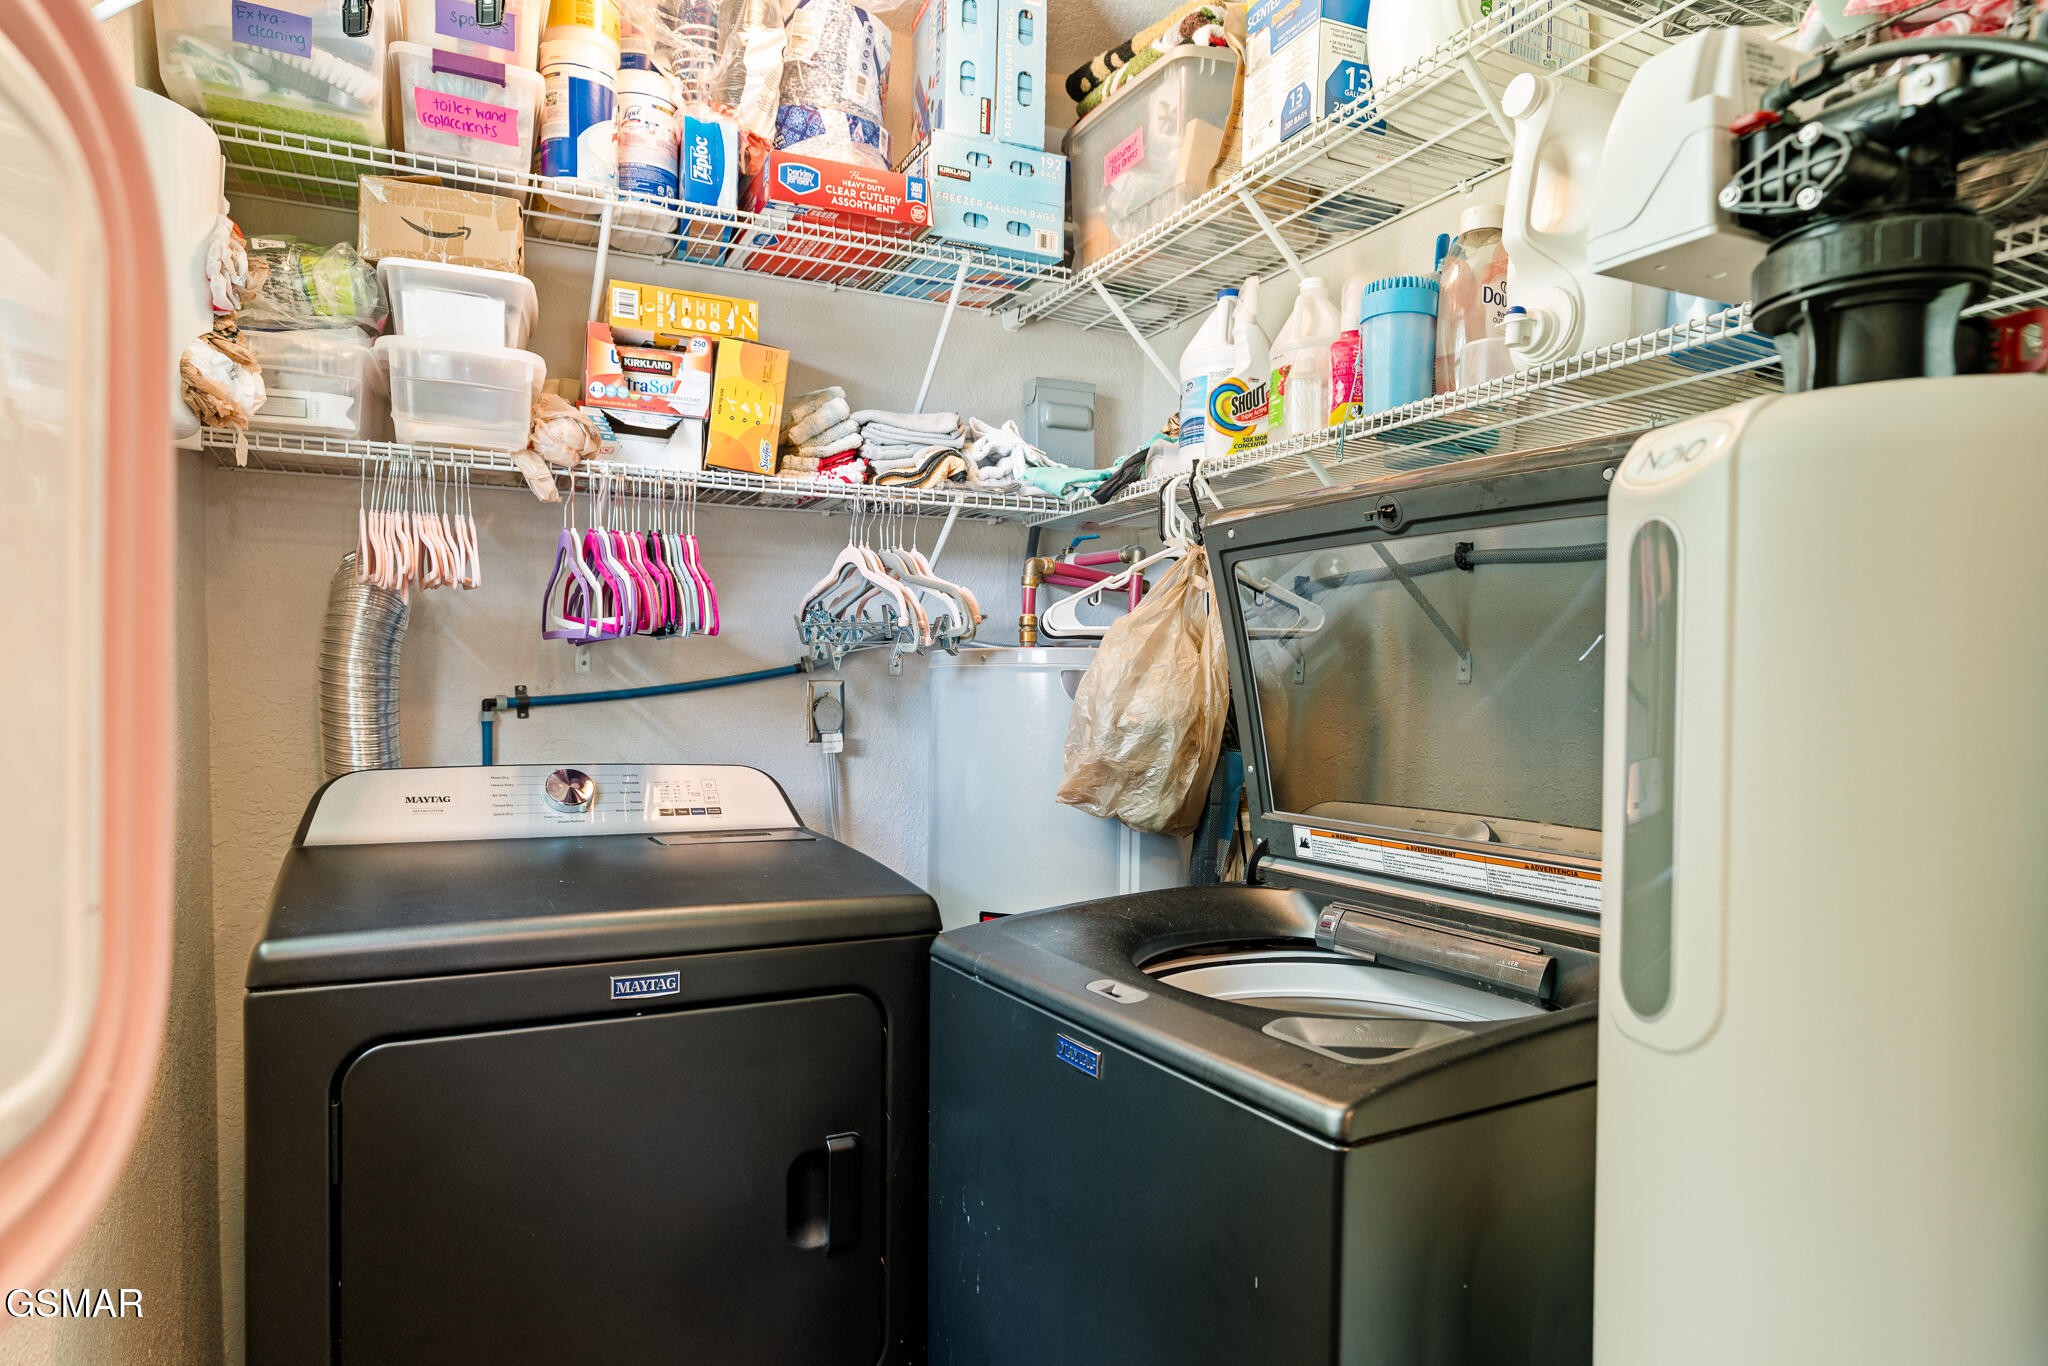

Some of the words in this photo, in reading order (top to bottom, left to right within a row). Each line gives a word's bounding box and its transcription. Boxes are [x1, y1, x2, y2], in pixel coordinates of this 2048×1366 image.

[449, 10, 509, 35] spos
[247, 24, 306, 51] Cleaning
[1004, 42, 1014, 82] QUART
[1345, 66, 1373, 93] 13
[1289, 85, 1304, 108] 13
[432, 97, 472, 115] toilet
[475, 107, 507, 123] wand
[1003, 85, 1014, 137] FREEZER
[422, 110, 499, 138] replacements
[693, 136, 713, 181] Ziploc
[1039, 156, 1063, 171] 192
[938, 165, 971, 178] KIRKLAND
[1040, 171, 1063, 181] BAGS
[825, 185, 857, 199] CLEAR
[859, 190, 902, 206] CUTLERY
[842, 179, 866, 190] HEAVY
[866, 184, 886, 194] DUTY
[831, 196, 896, 215] ASSORTMENT
[935, 191, 983, 208] FREEZER
[985, 201, 1027, 216] GALLON
[1029, 209, 1057, 223] BAGS
[693, 340, 706, 348] 250
[623, 357, 672, 371] KIRKLAND
[1231, 381, 1267, 417] SHOUT
[1233, 440, 1268, 450] CONCENTRA
[404, 795, 451, 804] MAYTAG
[1410, 844, 1457, 858] AVERTISSEMENT
[1530, 863, 1579, 878] ADVERTENCIA
[615, 977, 677, 995] MAYTAG
